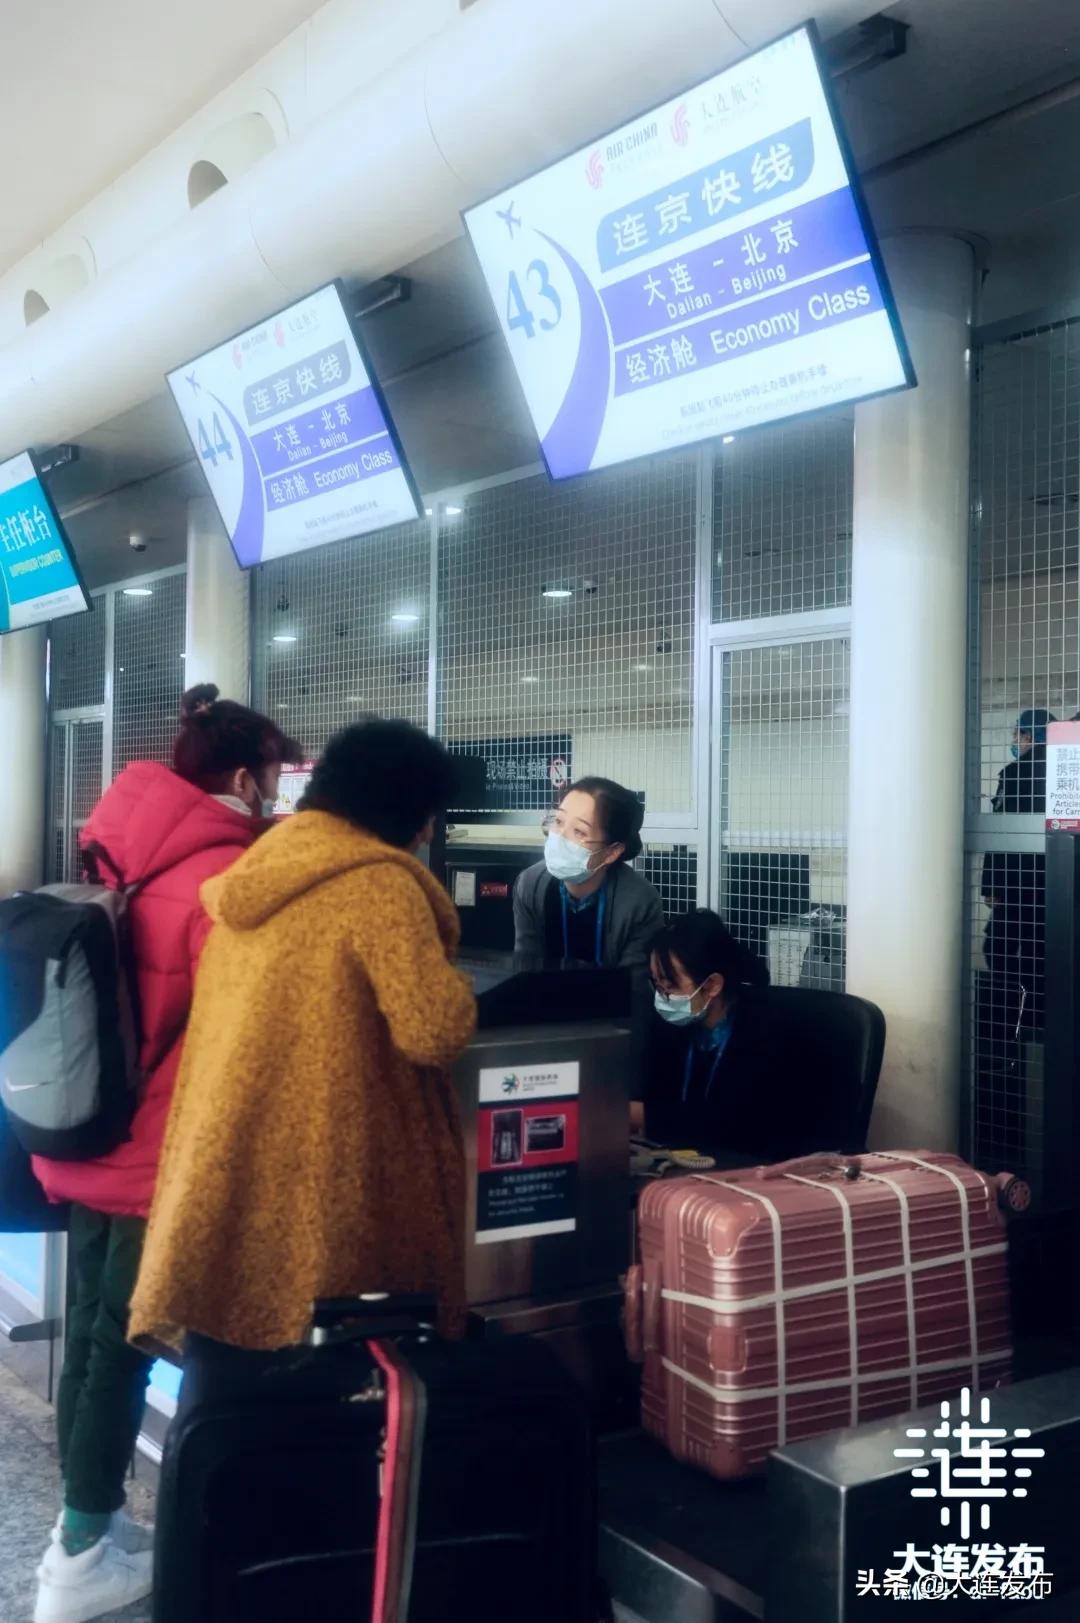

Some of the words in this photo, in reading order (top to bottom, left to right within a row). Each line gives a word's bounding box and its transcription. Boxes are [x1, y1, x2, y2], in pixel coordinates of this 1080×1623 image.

[606, 141, 624, 161] AIR
[626, 122, 658, 151] CHINA
[613, 142, 795, 257] 连京快线
[643, 262, 695, 307] 大连
[741, 219, 799, 266] 北京
[505, 258, 562, 340] 43
[666, 292, 713, 319] Dalian
[731, 264, 787, 296] Beijing
[626, 334, 697, 384] 经济舱
[709, 308, 801, 355] Economy
[807, 284, 871, 321] Class
[252, 353, 342, 416] 连京快线
[196, 411, 234, 467] 44
[273, 423, 301, 452] 大连
[321, 401, 351, 431] 北京
[288, 445, 312, 461] Dalian
[319, 431, 348, 449] Beijing
[271, 472, 310, 503] 经济舱
[313, 461, 360, 488] Economy
[361, 450, 393, 472] Class
[1053, 807, 1063, 815] for
